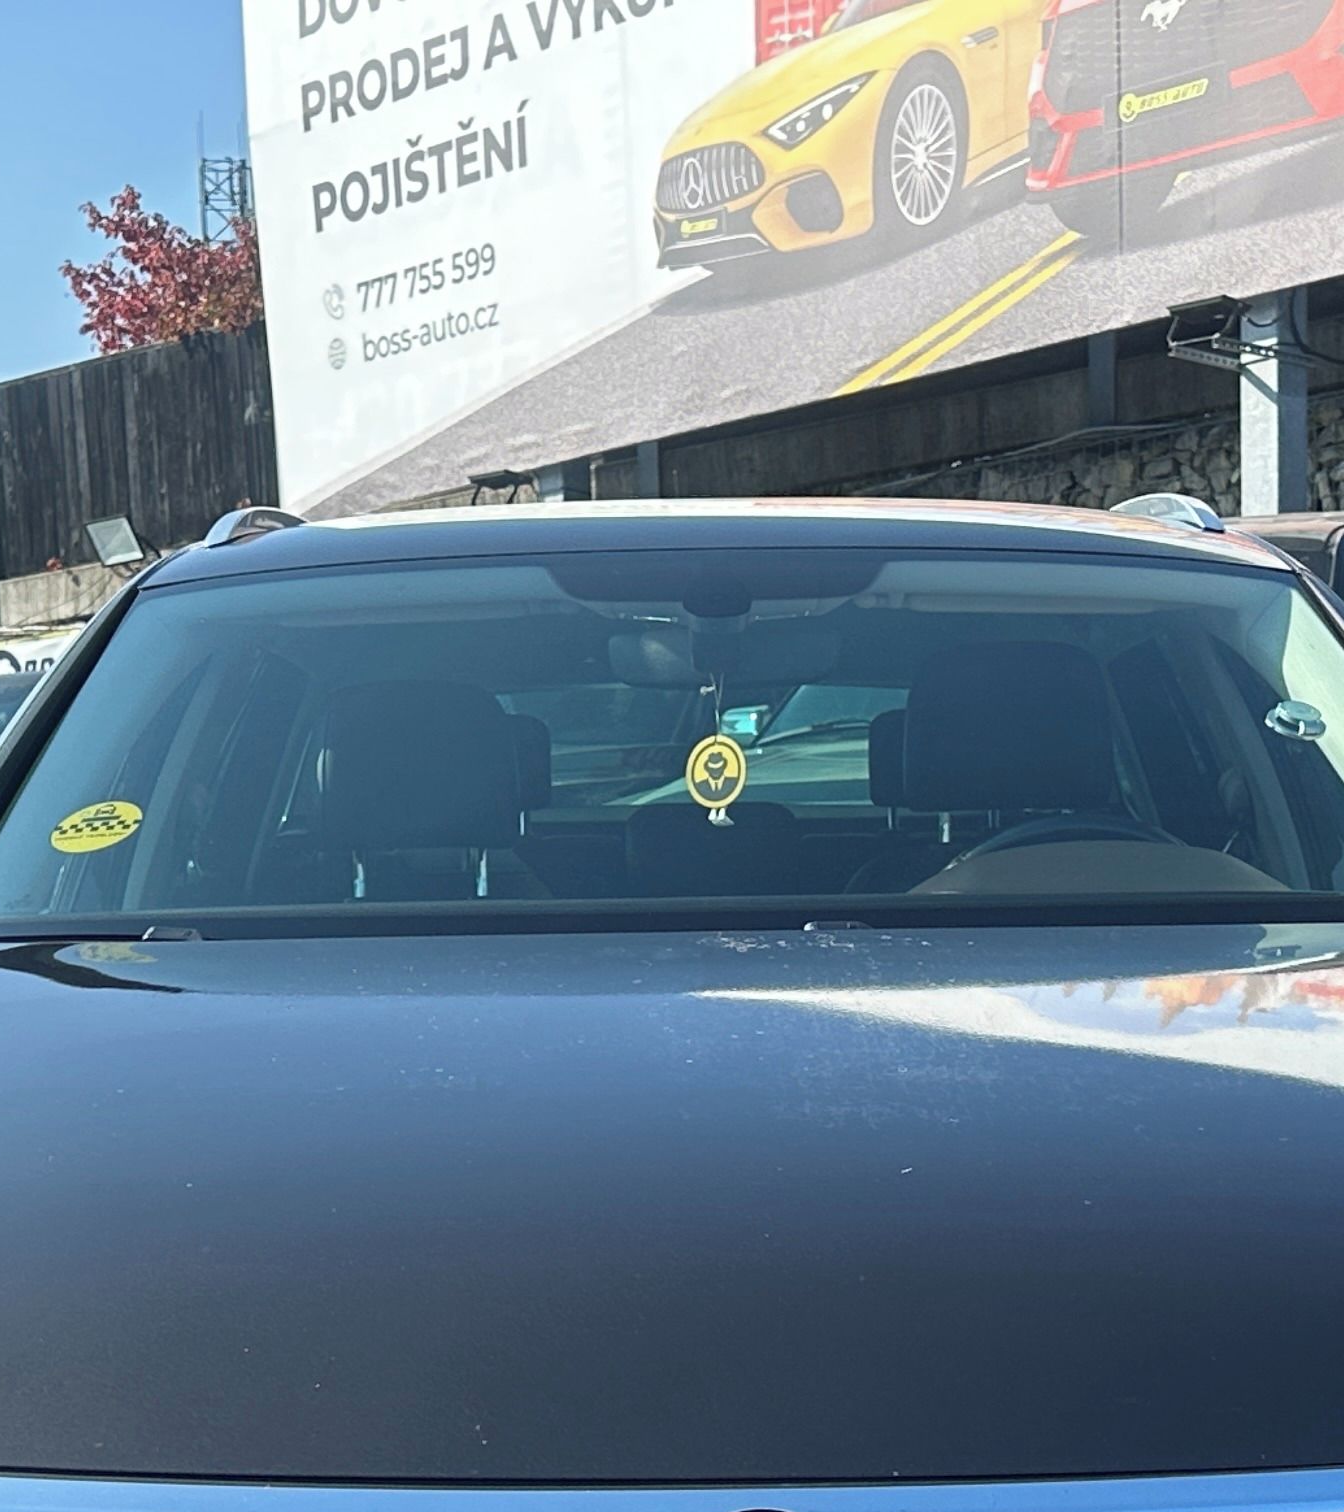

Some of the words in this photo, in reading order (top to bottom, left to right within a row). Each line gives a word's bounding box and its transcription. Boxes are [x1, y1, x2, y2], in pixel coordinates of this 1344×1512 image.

[301, 25, 470, 133] PRODEJ
[483, 13, 518, 71] A
[312, 98, 530, 233] POJIŠTĚNÍ
[356, 272, 398, 313] 777
[404, 258, 445, 299] 755
[451, 243, 495, 284] 599
[362, 303, 500, 362] boss-auto.cz
